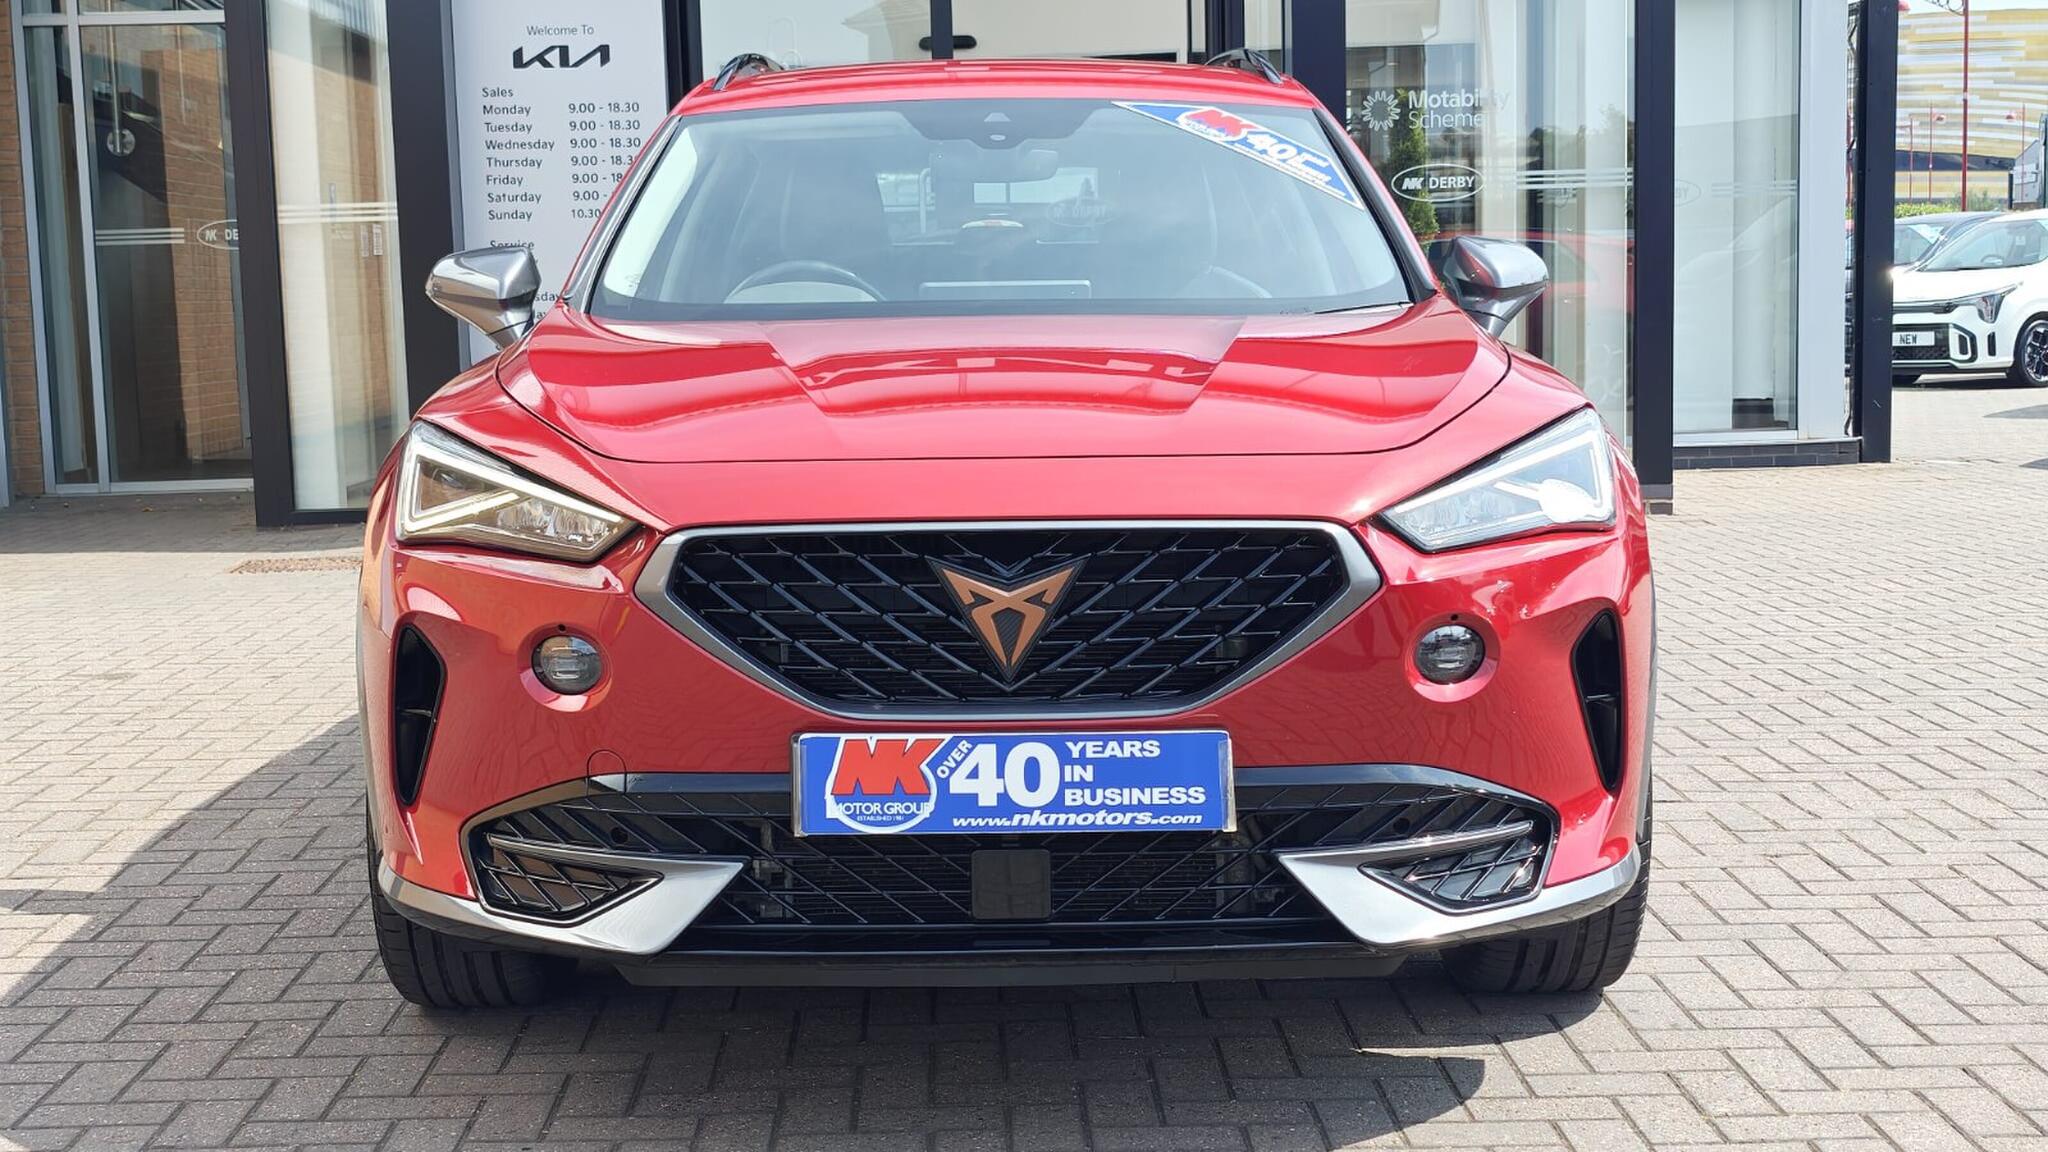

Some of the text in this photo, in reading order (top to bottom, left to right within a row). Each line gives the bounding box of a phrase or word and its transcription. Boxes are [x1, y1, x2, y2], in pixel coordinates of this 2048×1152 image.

[526, 24, 595, 36] Welcome To
[512, 44, 610, 69] KIA
[481, 87, 514, 98] Sales
[1408, 89, 1510, 113] Motabilty
[482, 104, 532, 117] Monday
[568, 102, 596, 114] 9.00
[608, 102, 640, 113] 18.30
[484, 122, 533, 134] Tuesday
[569, 120, 597, 131] 9.00
[609, 119, 641, 131] 18.30
[1408, 111, 1486, 129] Scheme
[485, 139, 555, 151] Wednesday
[570, 138, 598, 149] 9.00
[610, 137, 642, 148] 18.30
[486, 157, 543, 169] Thursday
[571, 155, 598, 166] 9.00
[486, 174, 524, 186] Friday
[572, 173, 599, 184] 9.00
[1402, 176, 1475, 190] NK DERBY
[487, 192, 542, 204] Saturday
[573, 190, 600, 201] 9.00
[488, 209, 533, 222] Sunday
[1899, 334, 1917, 345] NEW
[1065, 741, 1161, 759] YEARS
[936, 739, 973, 779] OVER
[831, 738, 945, 796] NK
[949, 741, 1061, 808] 40
[1064, 765, 1093, 782] IN
[1064, 786, 1207, 807] BUSINESS
[883, 802, 931, 815] GROUP
[952, 809, 1203, 827] www.nkmotors.com
